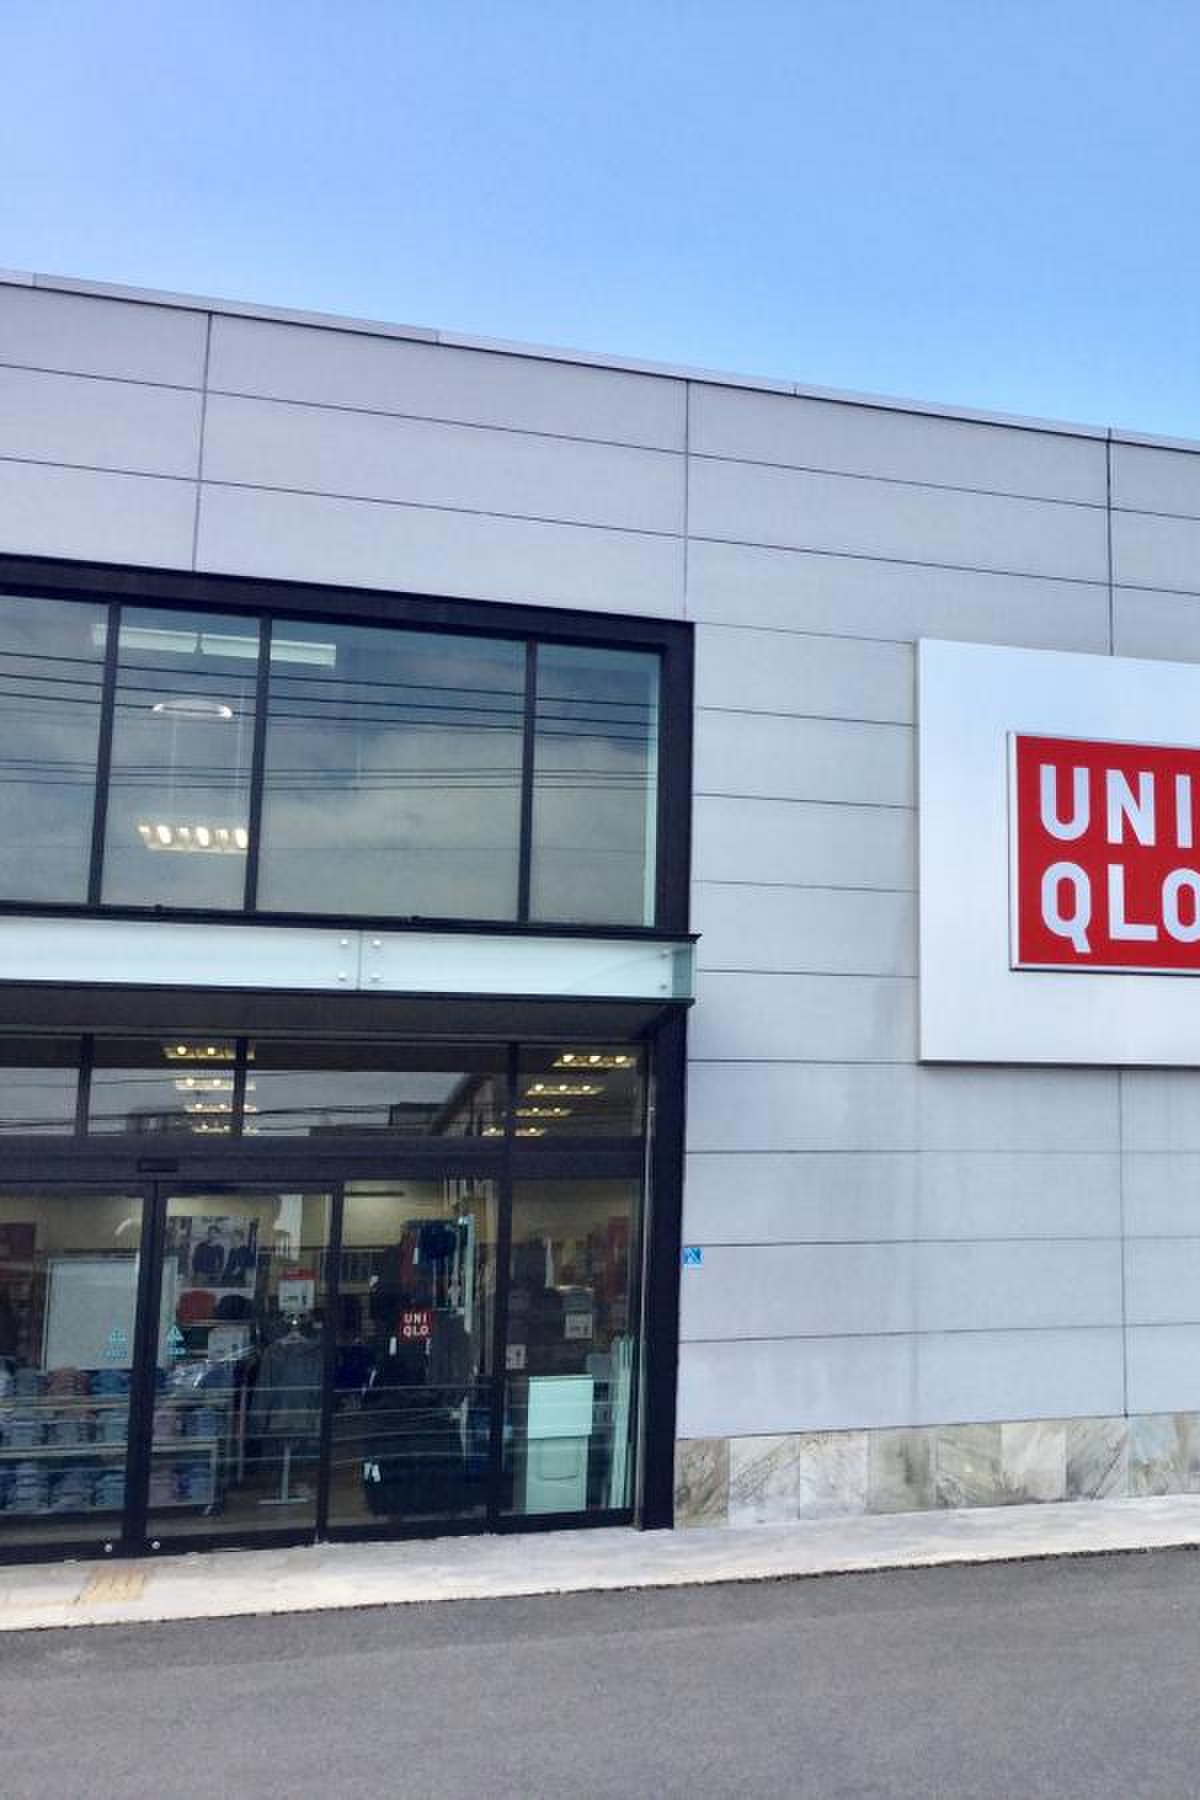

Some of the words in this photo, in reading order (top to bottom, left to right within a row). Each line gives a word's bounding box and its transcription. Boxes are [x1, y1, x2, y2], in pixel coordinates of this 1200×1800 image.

[1040, 764, 1193, 849] UNI
[404, 1312, 427, 1324] UNI
[403, 1325, 429, 1337] QLO
